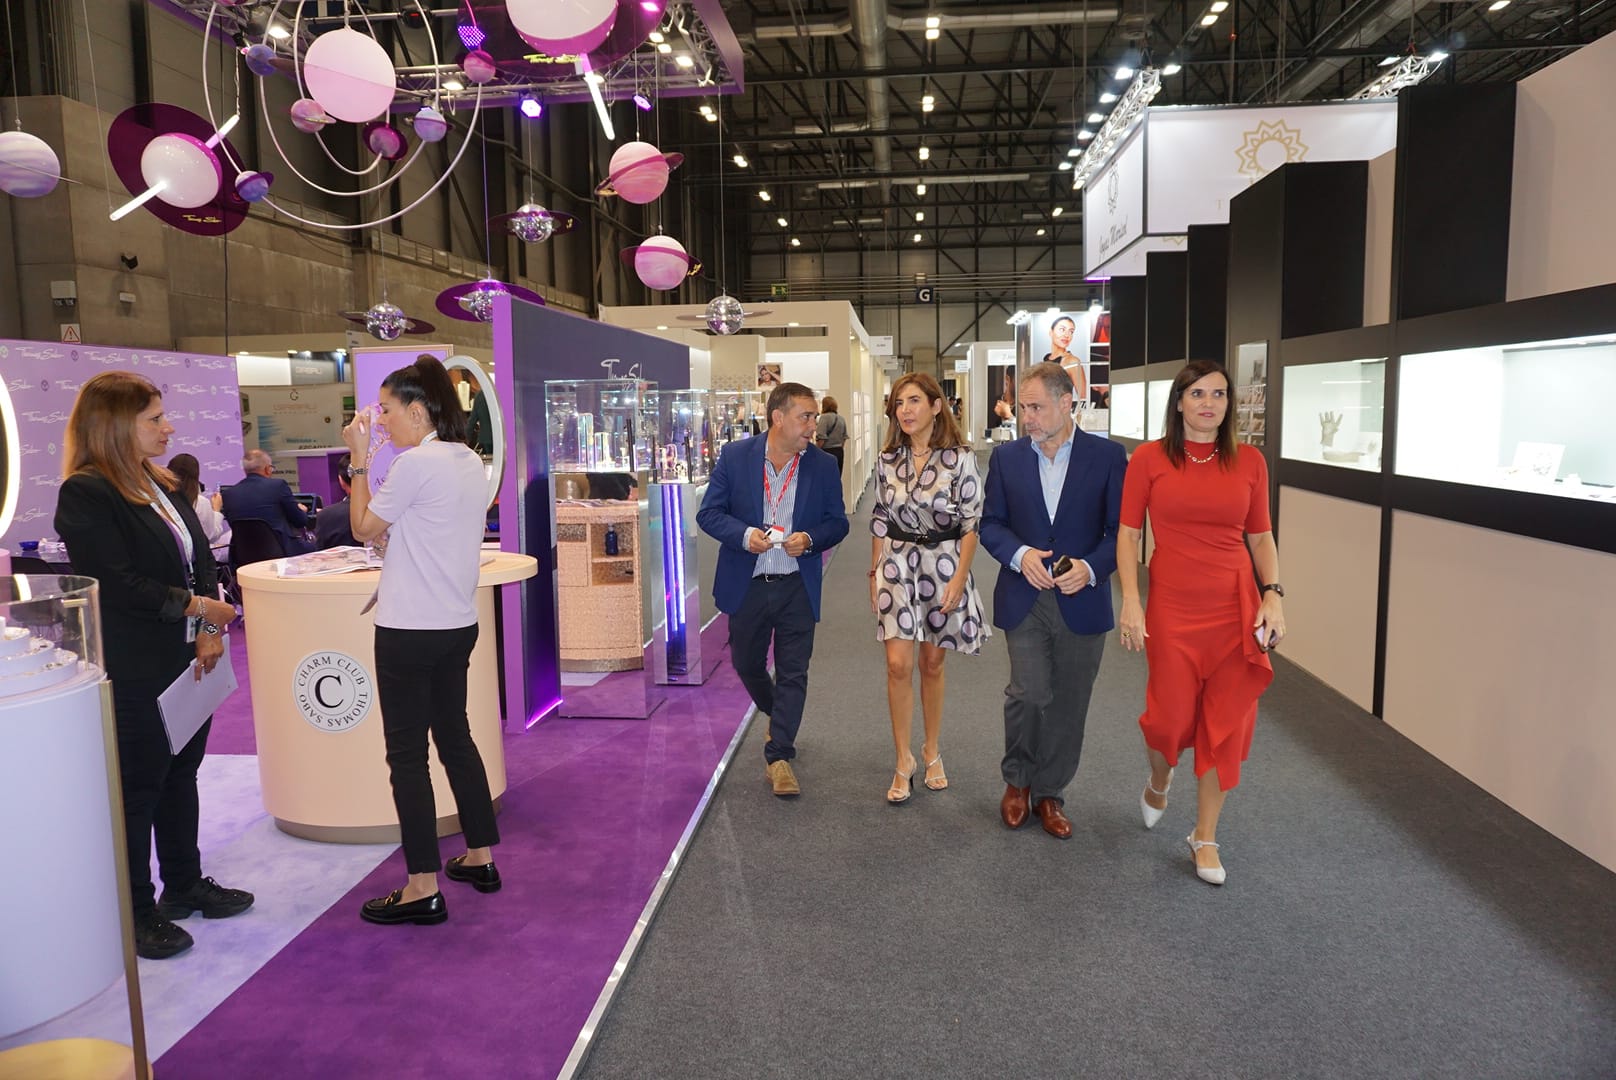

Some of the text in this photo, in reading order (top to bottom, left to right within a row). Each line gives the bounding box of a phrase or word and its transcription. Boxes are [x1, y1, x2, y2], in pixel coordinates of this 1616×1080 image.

[919, 288, 930, 302] G
[298, 656, 365, 687] CHARM CLUB
[315, 675, 344, 708] C
[299, 691, 368, 727] THOMAS SABO
